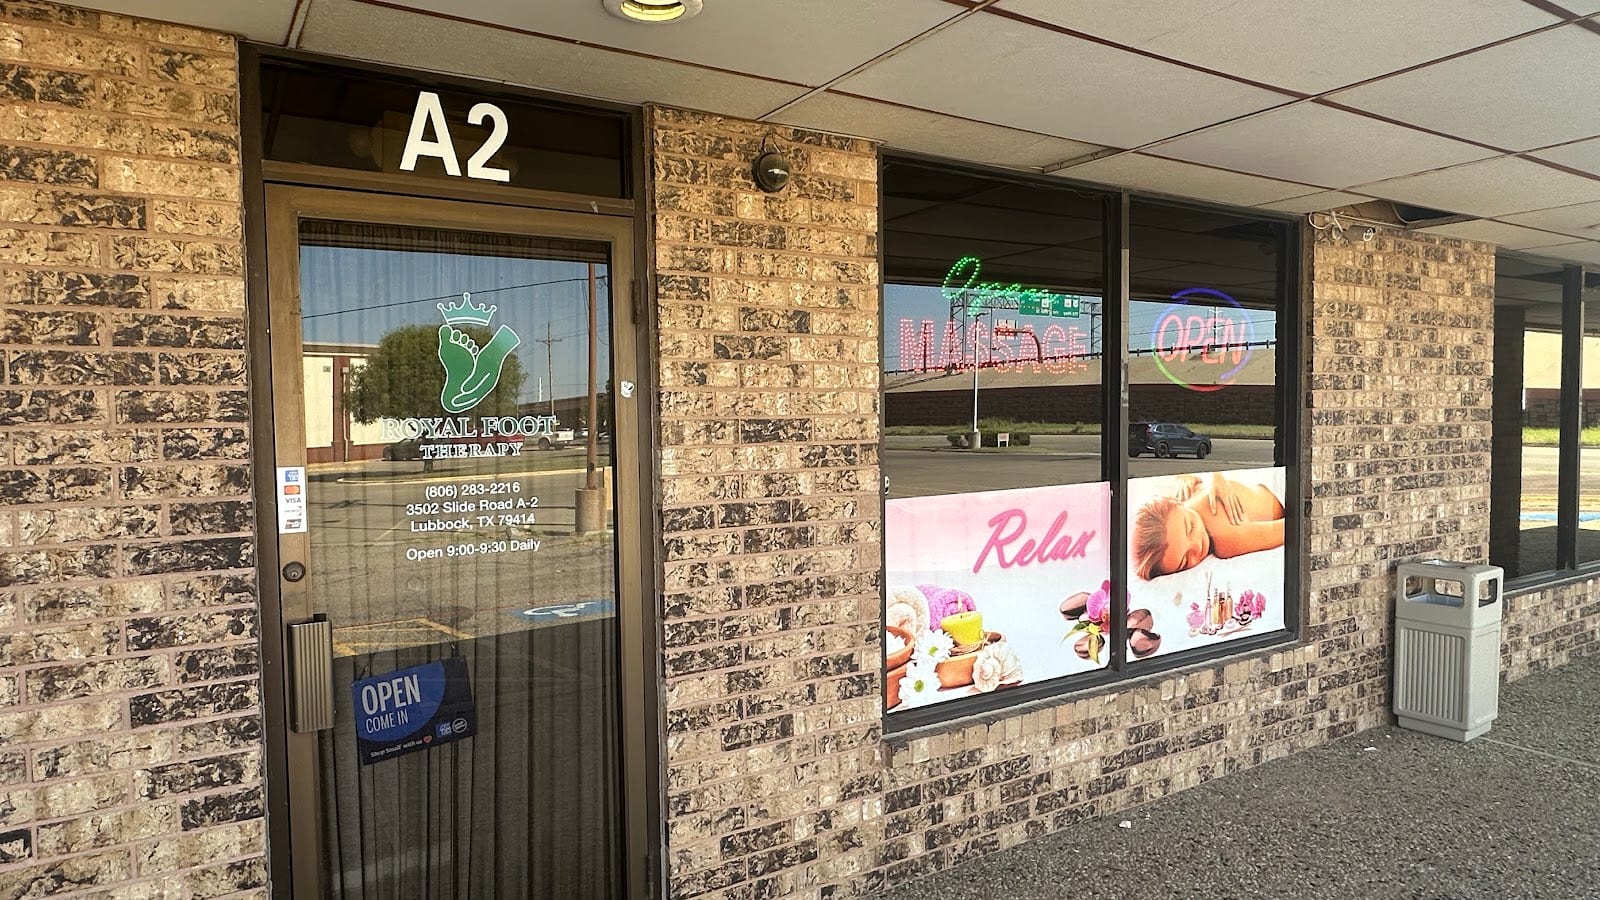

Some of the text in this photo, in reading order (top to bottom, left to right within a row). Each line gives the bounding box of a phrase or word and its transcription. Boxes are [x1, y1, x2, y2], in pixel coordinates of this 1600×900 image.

[400, 91, 510, 182] A2
[899, 318, 1088, 374] MASSAGE
[1157, 314, 1246, 365] OPEN
[380, 415, 556, 440] ROYAL FOOT
[419, 442, 524, 459] THERAPY
[425, 482, 521, 500] (806) 283-2216
[406, 496, 539, 516] 3502 Slide Road A-2
[410, 513, 536, 533] Lubbock, TX 79414
[406, 538, 541, 562] Open 9:00-9:30 Daily
[973, 508, 1096, 574] Relax
[361, 674, 421, 715] OPEN
[366, 709, 409, 734] COME IN
